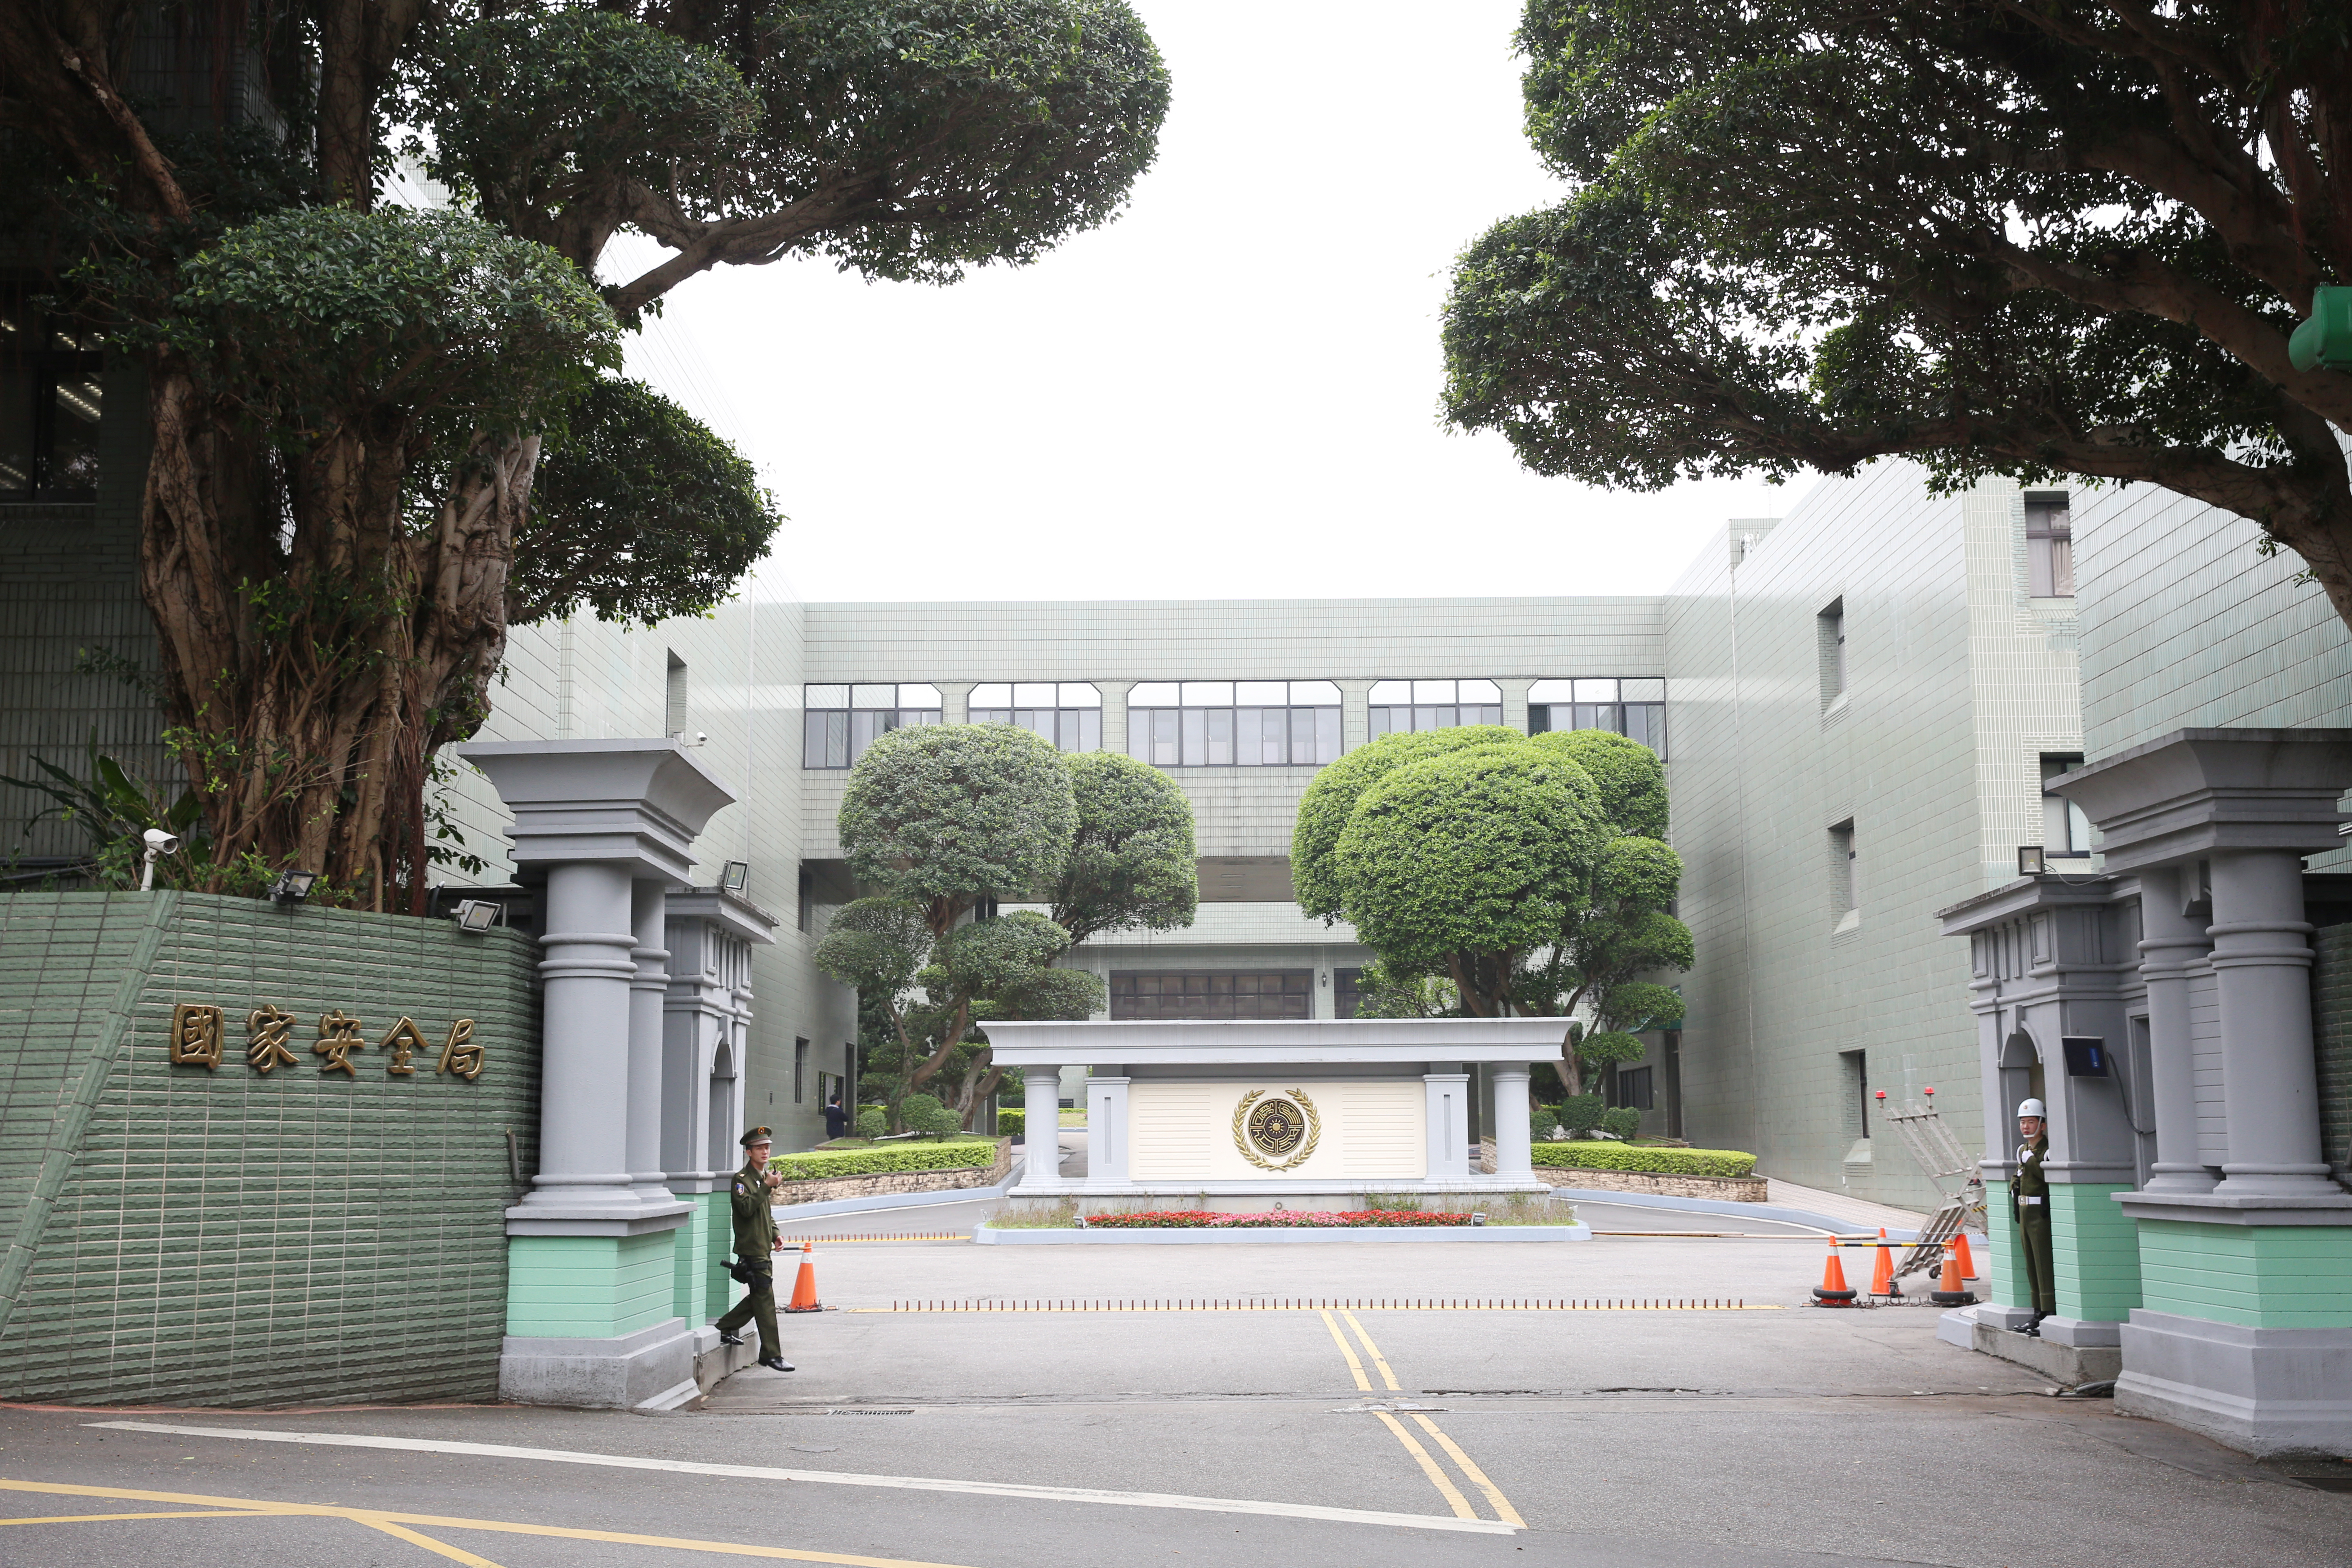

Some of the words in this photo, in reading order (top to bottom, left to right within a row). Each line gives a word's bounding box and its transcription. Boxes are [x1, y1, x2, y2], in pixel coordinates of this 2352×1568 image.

[170, 1003, 485, 1080] 國家安全局
